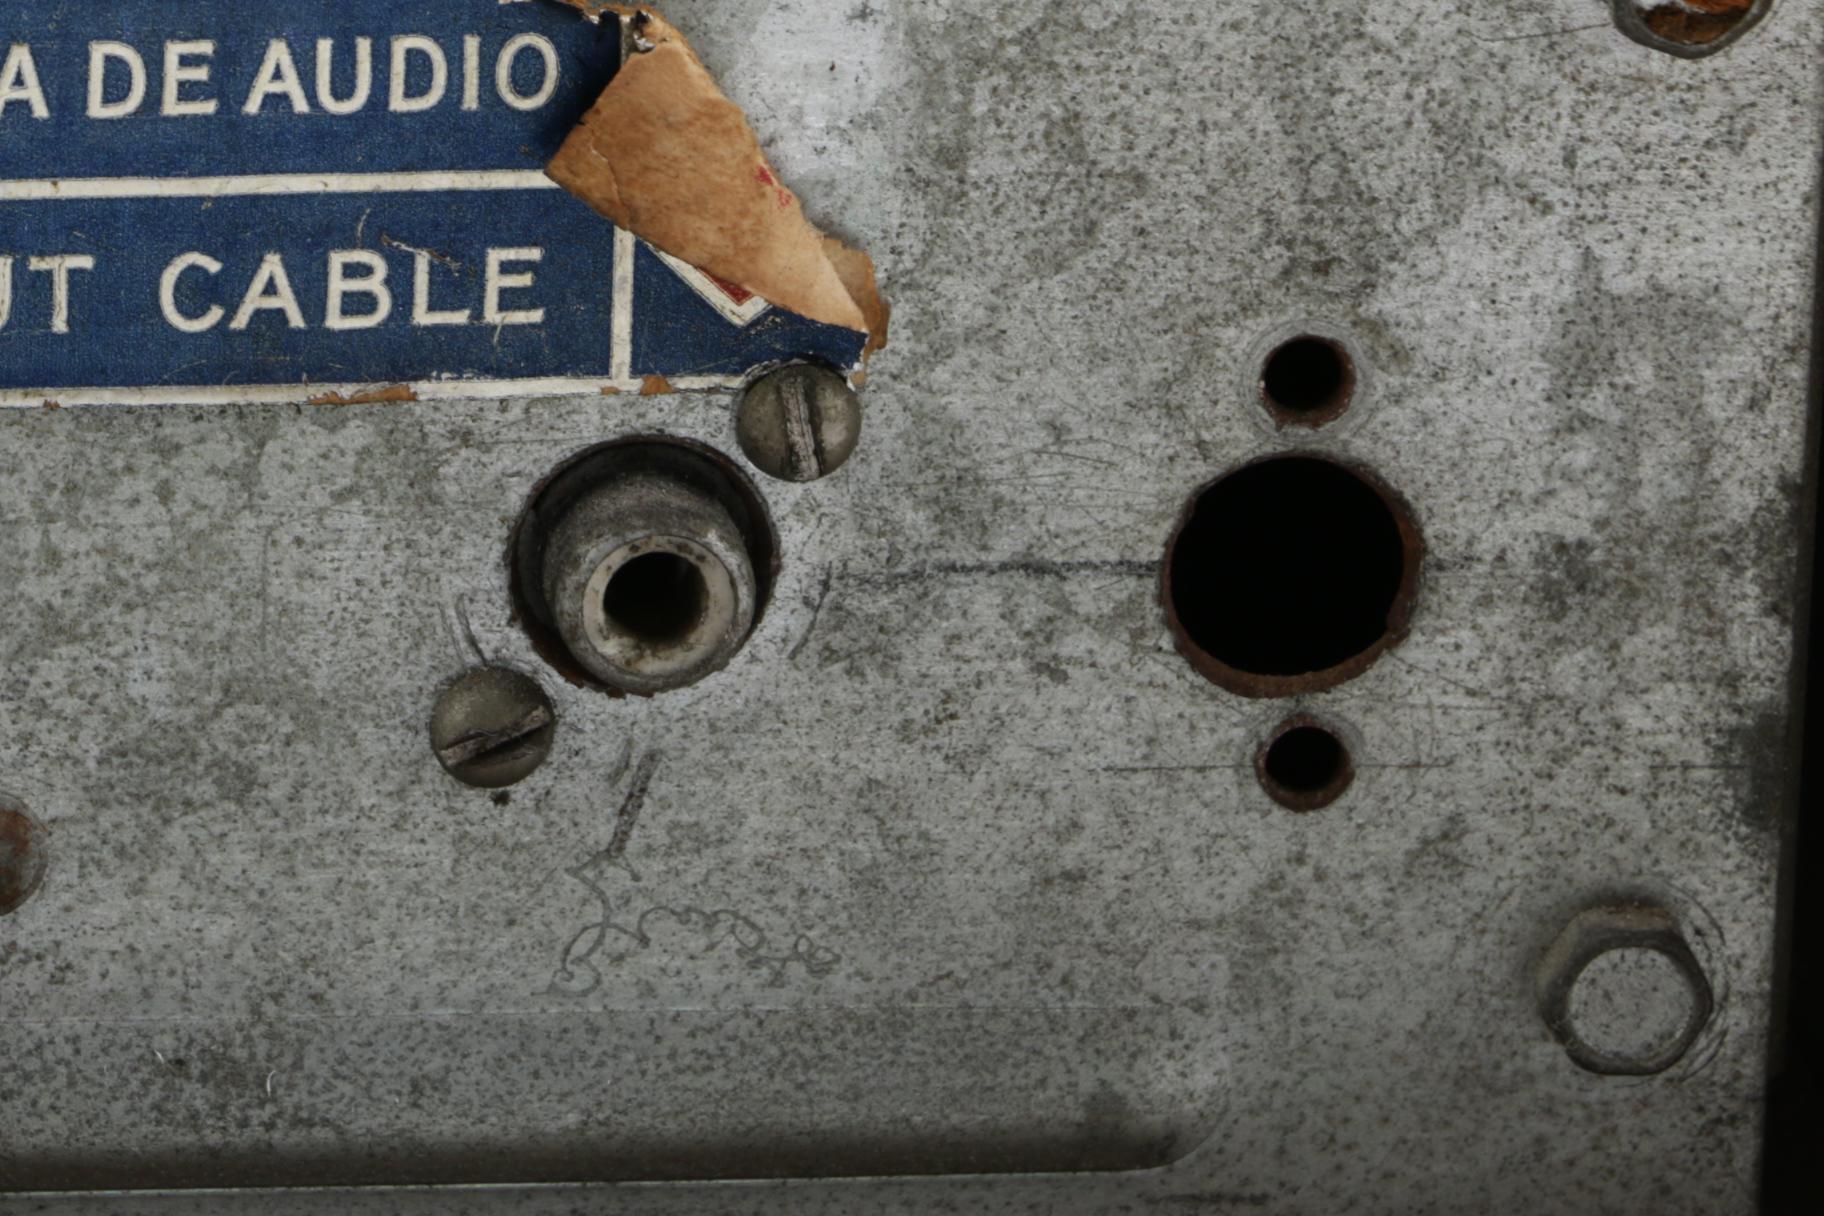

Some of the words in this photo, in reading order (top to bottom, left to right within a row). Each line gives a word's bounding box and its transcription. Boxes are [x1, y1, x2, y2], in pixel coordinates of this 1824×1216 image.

[85, 38, 218, 120] DE
[241, 31, 559, 117] AUDIO
[158, 246, 545, 334] CABLE
